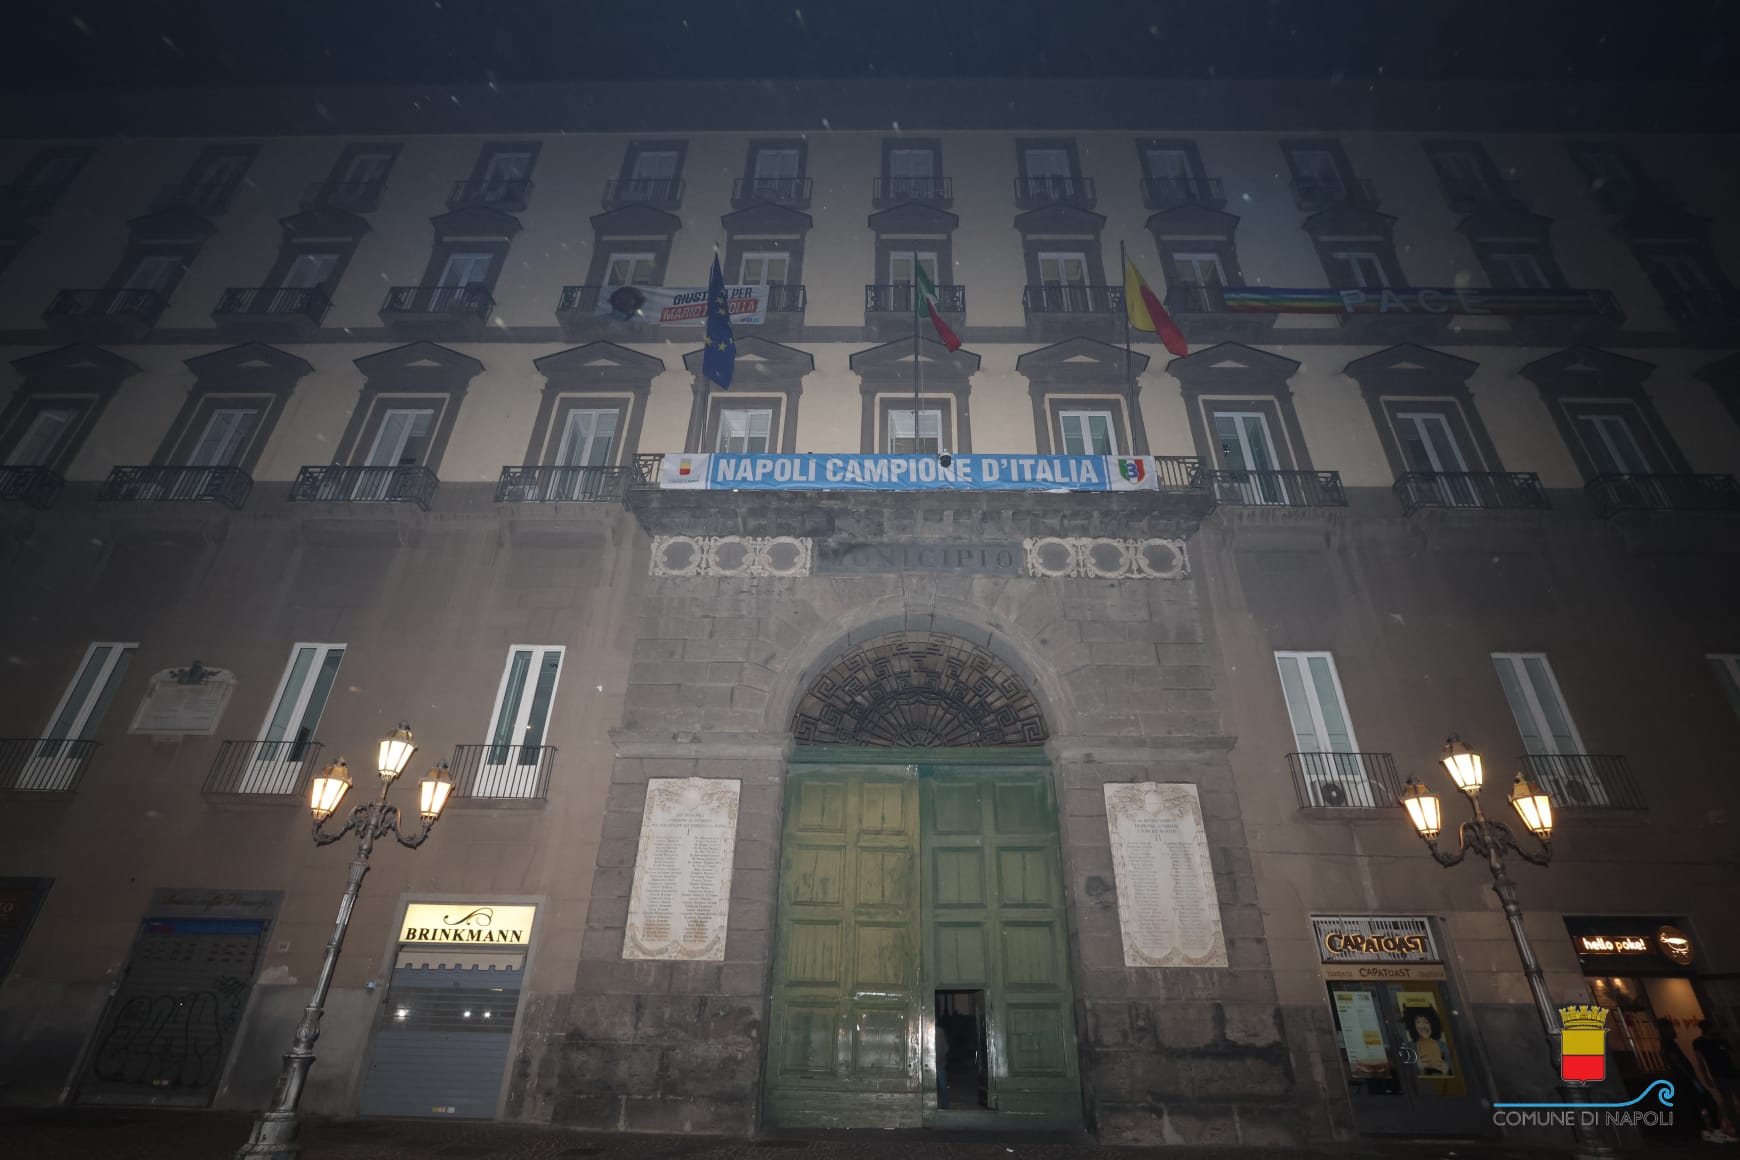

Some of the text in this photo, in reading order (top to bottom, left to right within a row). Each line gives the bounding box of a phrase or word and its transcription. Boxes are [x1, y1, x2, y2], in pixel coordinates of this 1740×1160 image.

[731, 287, 753, 299] PER
[1339, 289, 1492, 314] PACE
[662, 304, 701, 322] MARIO
[716, 458, 1099, 484] NAPOLI CAMPIONE D'ITALIA
[1126, 462, 1139, 478] 3
[405, 927, 524, 943] BRINKMANN
[1325, 932, 1430, 954] CAPATOAST
[1582, 937, 1647, 953] hello poke!
[1358, 967, 1412, 978] CAPATOAST
